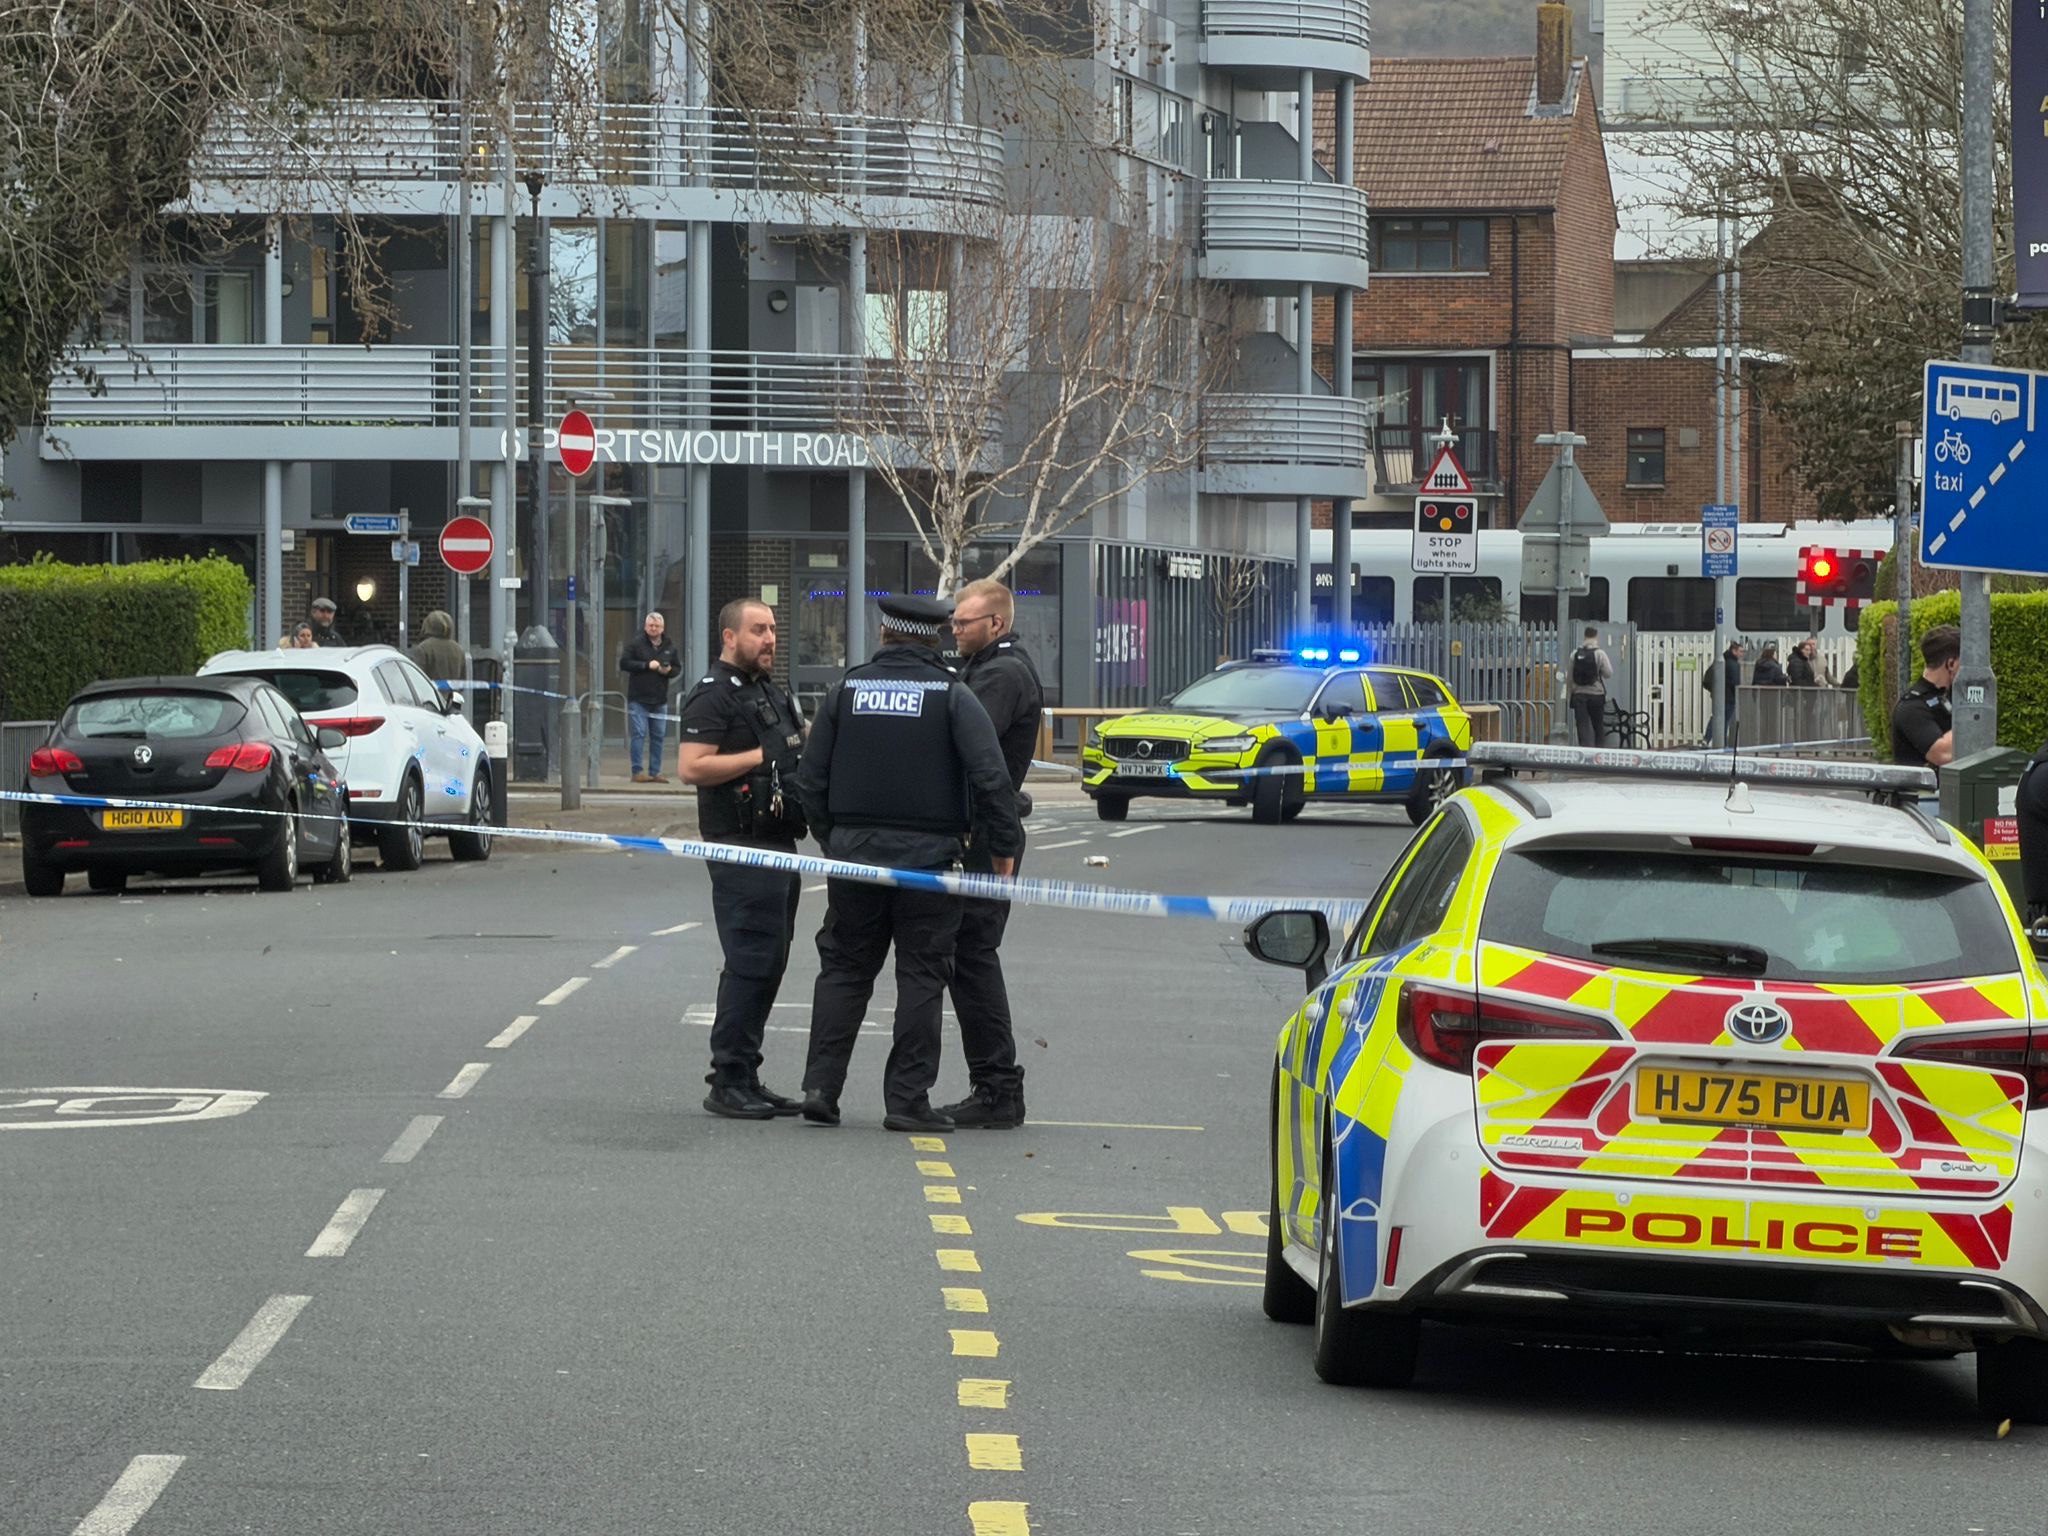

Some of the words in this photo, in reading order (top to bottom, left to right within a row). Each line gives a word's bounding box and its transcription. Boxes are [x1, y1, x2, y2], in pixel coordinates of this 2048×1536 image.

[543, 428, 782, 464] PRTSMOUTH
[793, 432, 869, 467] ROAD
[1934, 470, 1963, 492] taxi
[1429, 537, 1462, 547] STOP
[1417, 559, 1443, 568] lights
[1447, 560, 1471, 568] show
[1432, 550, 1457, 558] when
[856, 691, 919, 712] POLICE
[112, 813, 142, 824] HG10
[147, 811, 173, 824] AUX
[1654, 1074, 1761, 1117] HJ75
[1773, 1081, 1850, 1122] PUA
[1564, 1208, 1923, 1258] POLICE
